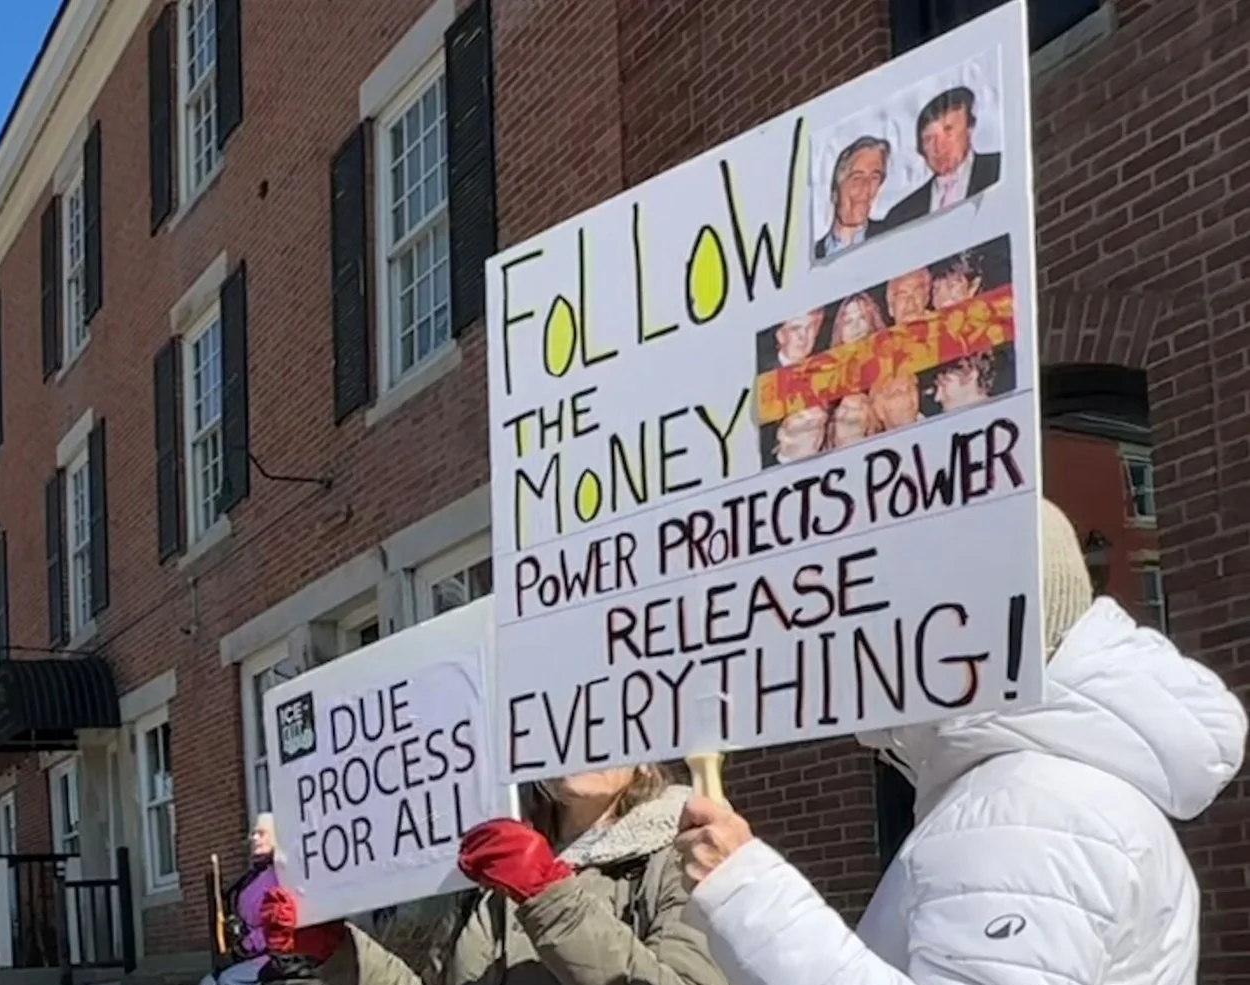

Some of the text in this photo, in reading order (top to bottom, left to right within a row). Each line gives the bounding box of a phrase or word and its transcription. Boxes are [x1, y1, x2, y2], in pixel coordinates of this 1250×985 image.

[503, 386, 601, 458] THE
[607, 547, 891, 665] RELEASE
[329, 680, 414, 755] DUE
[509, 593, 1027, 775] EVERYTHING!
[297, 720, 476, 822] PROCESS
[301, 816, 376, 880] FOR
